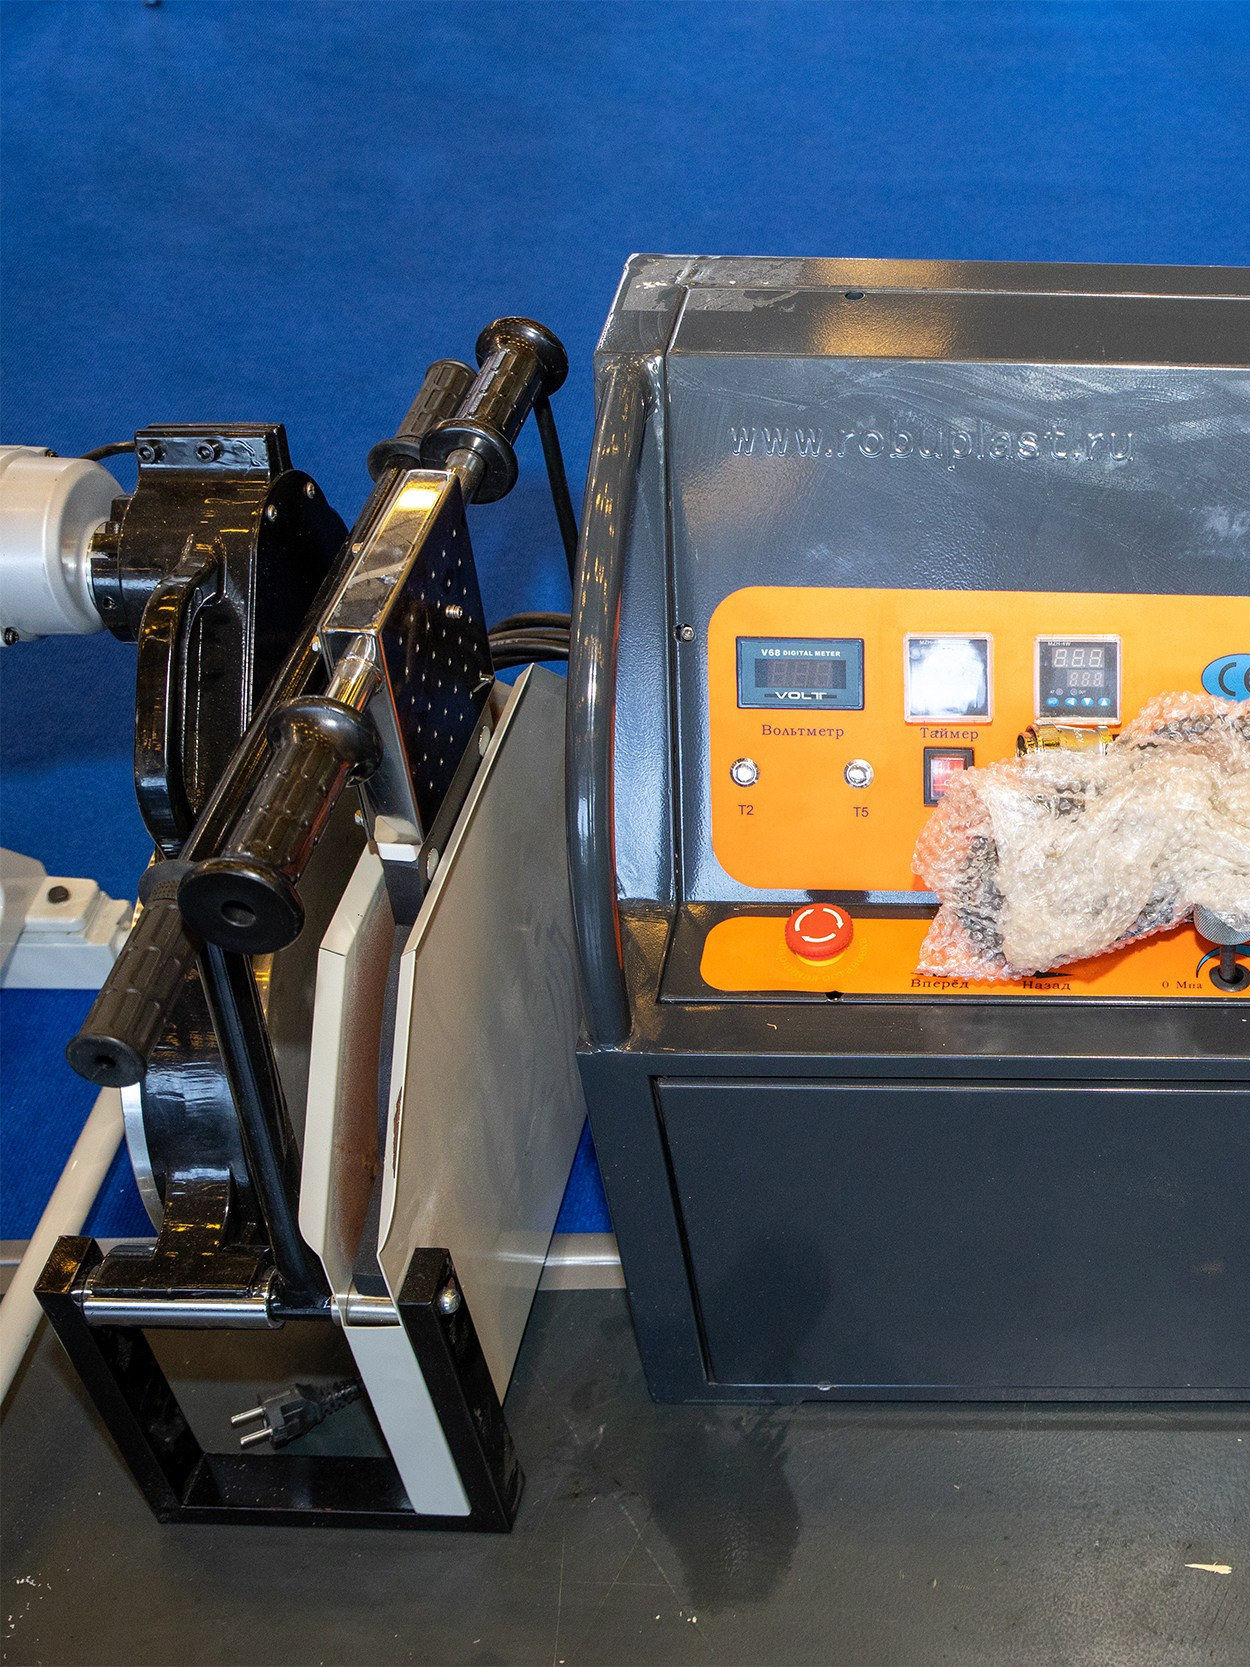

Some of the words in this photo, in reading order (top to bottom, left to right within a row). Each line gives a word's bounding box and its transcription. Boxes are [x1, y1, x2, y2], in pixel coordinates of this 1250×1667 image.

[730, 420, 1134, 471] www.robuplast.ru
[775, 691, 827, 700] VOLT
[761, 724, 844, 740] Вольтметр
[920, 727, 979, 742] Таймер
[738, 805, 754, 816] T2
[853, 807, 869, 817] T5
[911, 979, 969, 990] Вперёд
[1023, 981, 1071, 990] Назад
[1162, 981, 1169, 989] 0
[1176, 981, 1202, 989] Мпа
